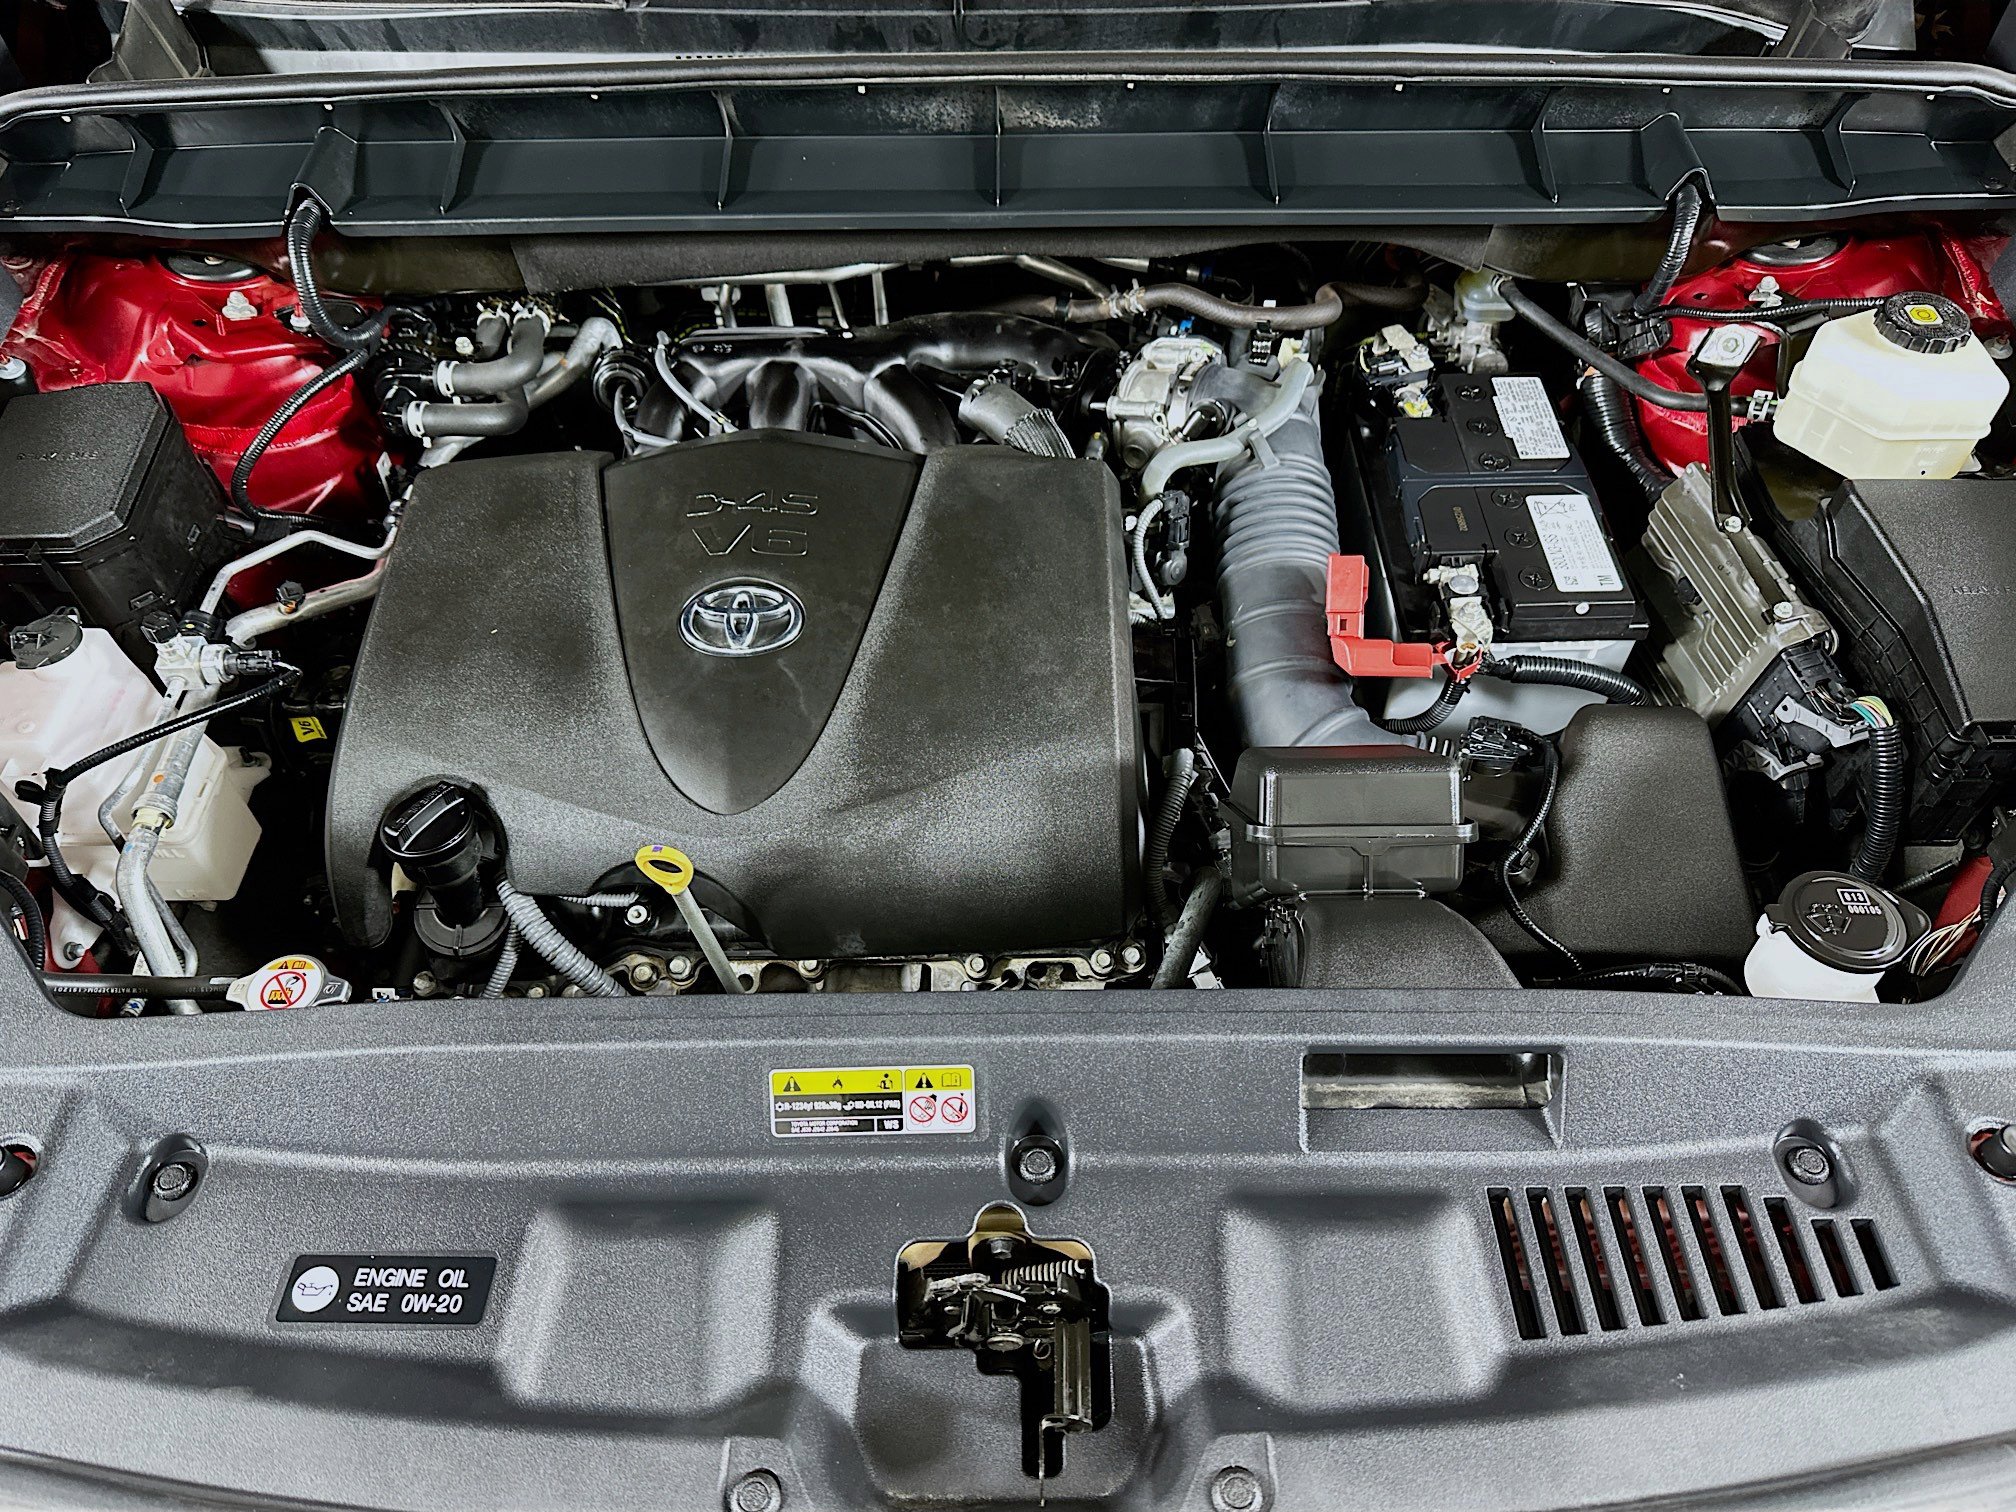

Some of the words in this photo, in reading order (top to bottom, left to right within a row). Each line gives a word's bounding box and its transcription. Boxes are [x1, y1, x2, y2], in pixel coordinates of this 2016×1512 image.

[686, 492, 818, 518] D-4S
[692, 523, 808, 556] V6
[1597, 574, 1615, 586] TM
[298, 720, 315, 736] V6
[354, 1267, 428, 1288] ENGINE
[438, 1268, 469, 1288] OIL
[346, 1292, 390, 1313] SAE
[400, 1293, 463, 1314] 0W-20
